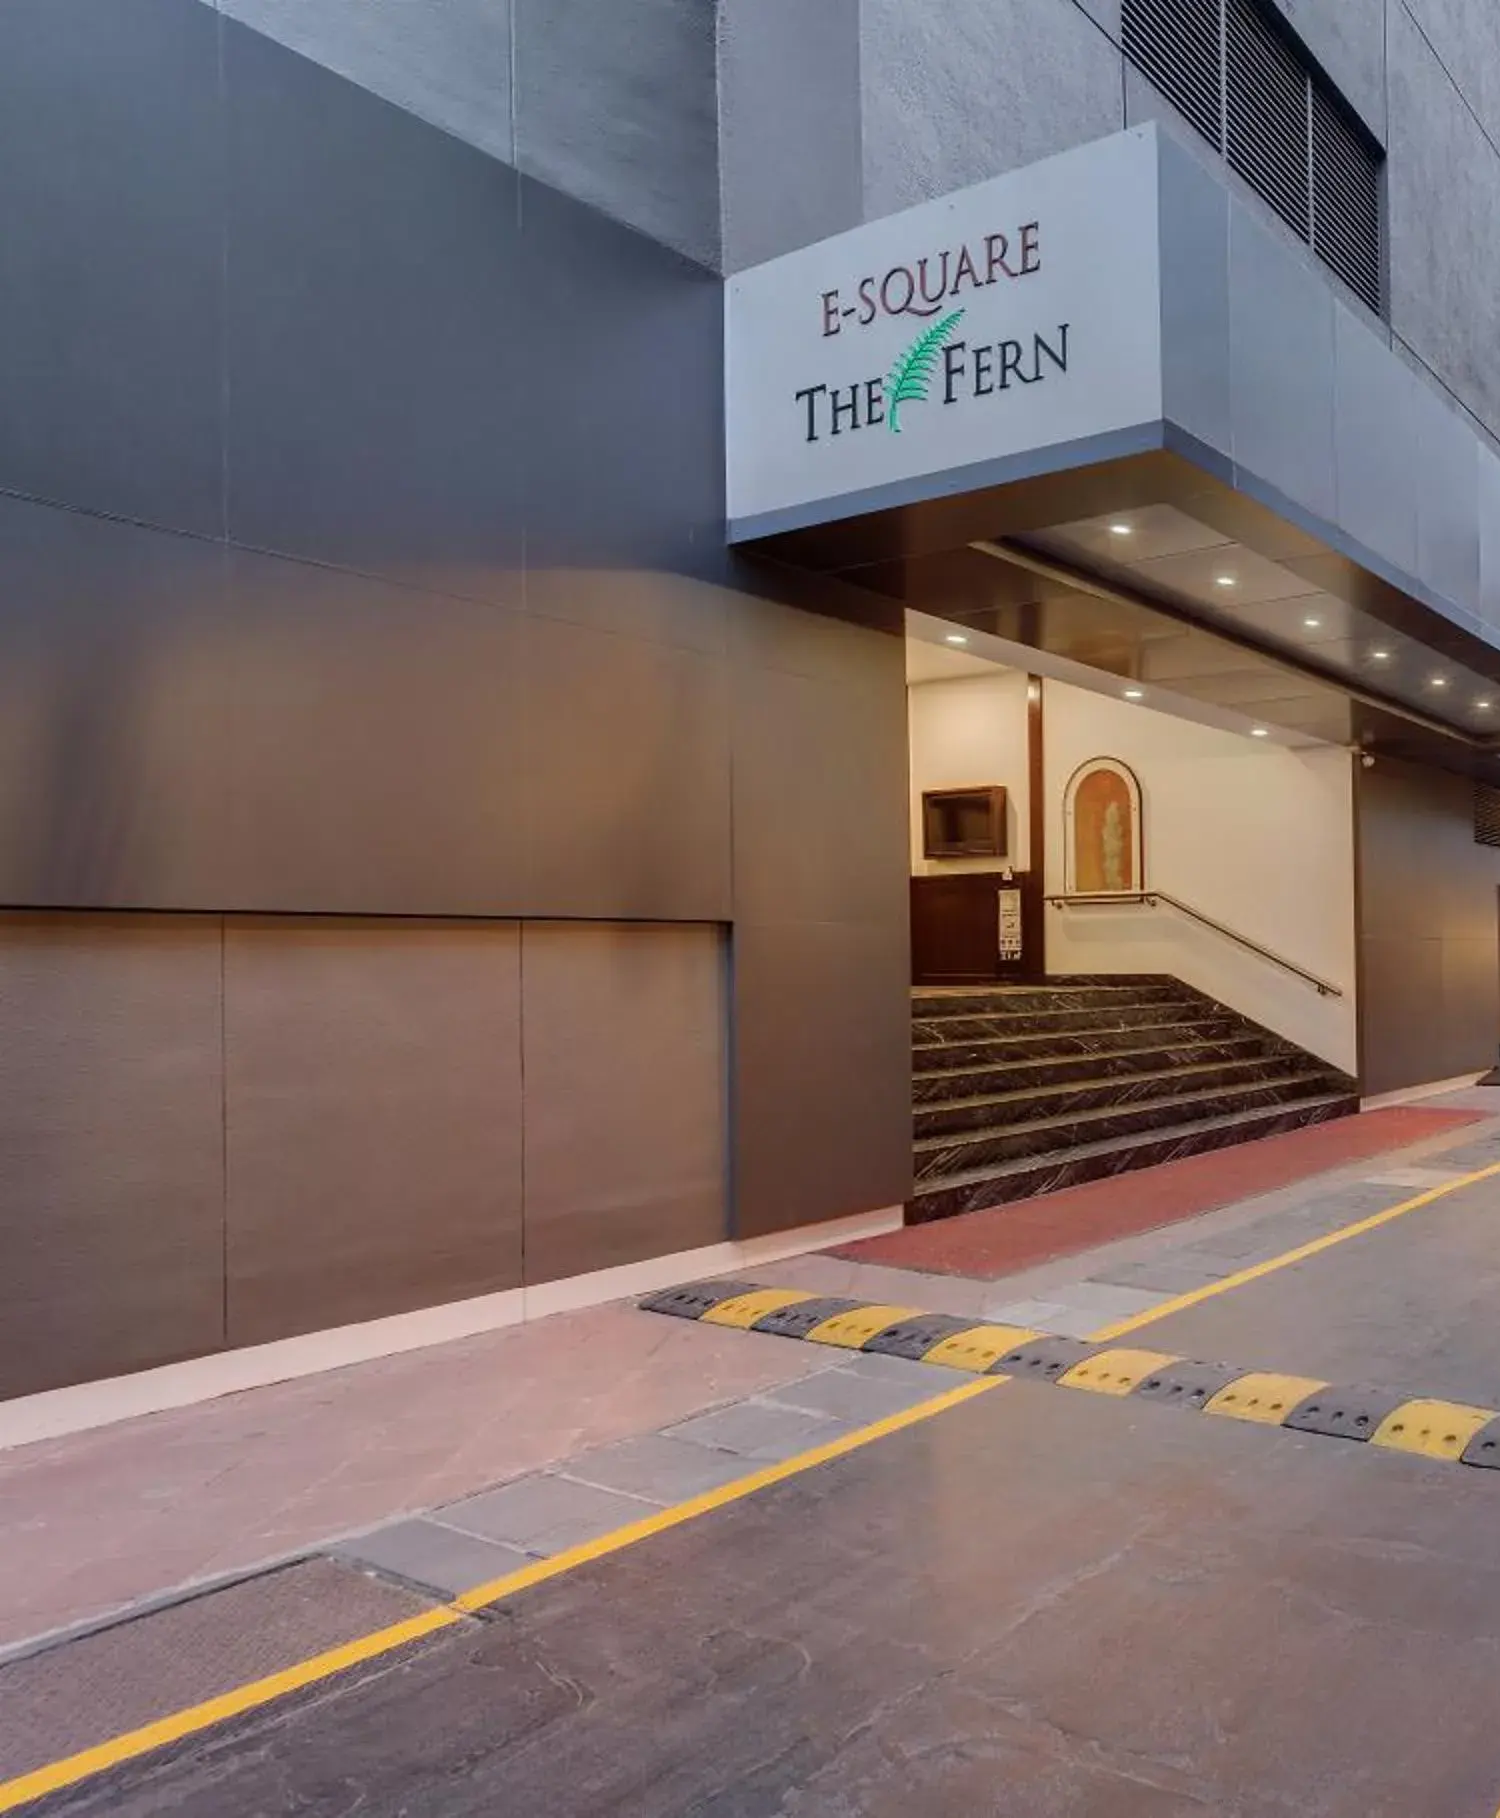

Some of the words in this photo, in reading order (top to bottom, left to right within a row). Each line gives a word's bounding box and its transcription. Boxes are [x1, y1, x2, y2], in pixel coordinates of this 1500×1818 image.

[821, 220, 1041, 337] E-SQUARE
[795, 377, 885, 442] THE
[941, 323, 1070, 405] FERN
